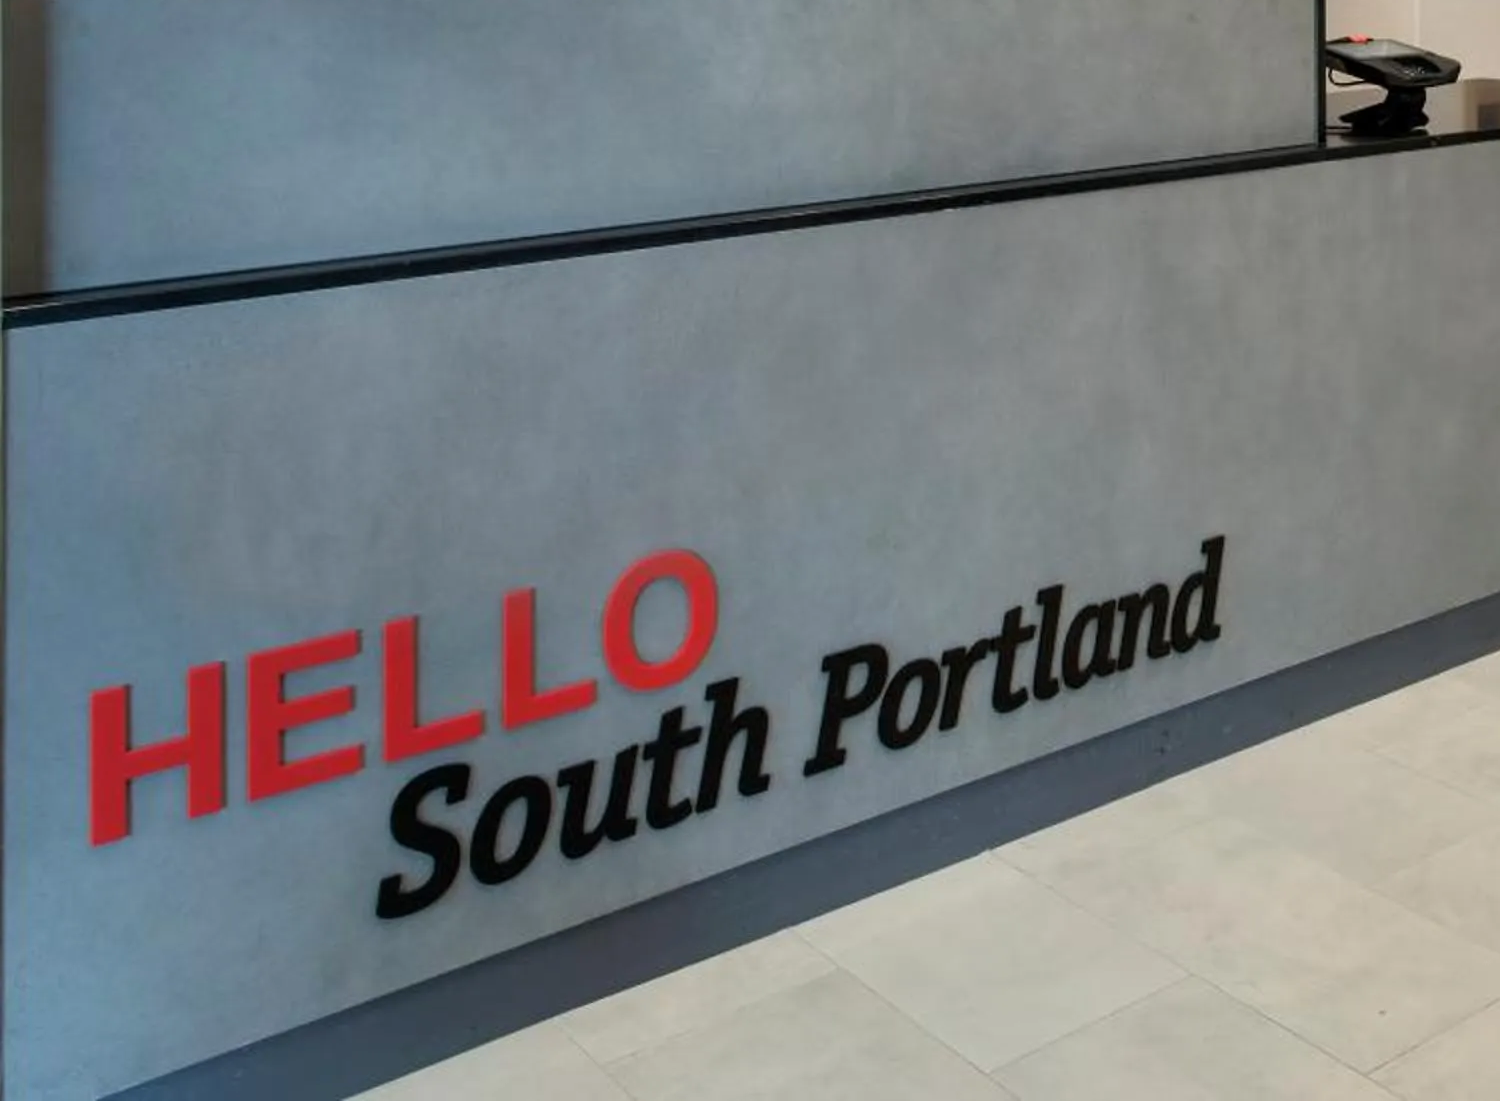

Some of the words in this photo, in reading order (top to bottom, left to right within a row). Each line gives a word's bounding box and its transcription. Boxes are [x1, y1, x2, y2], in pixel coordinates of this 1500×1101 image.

[89, 549, 720, 848] HELLO
[375, 676, 771, 920] South
[802, 535, 1225, 777] Portland
